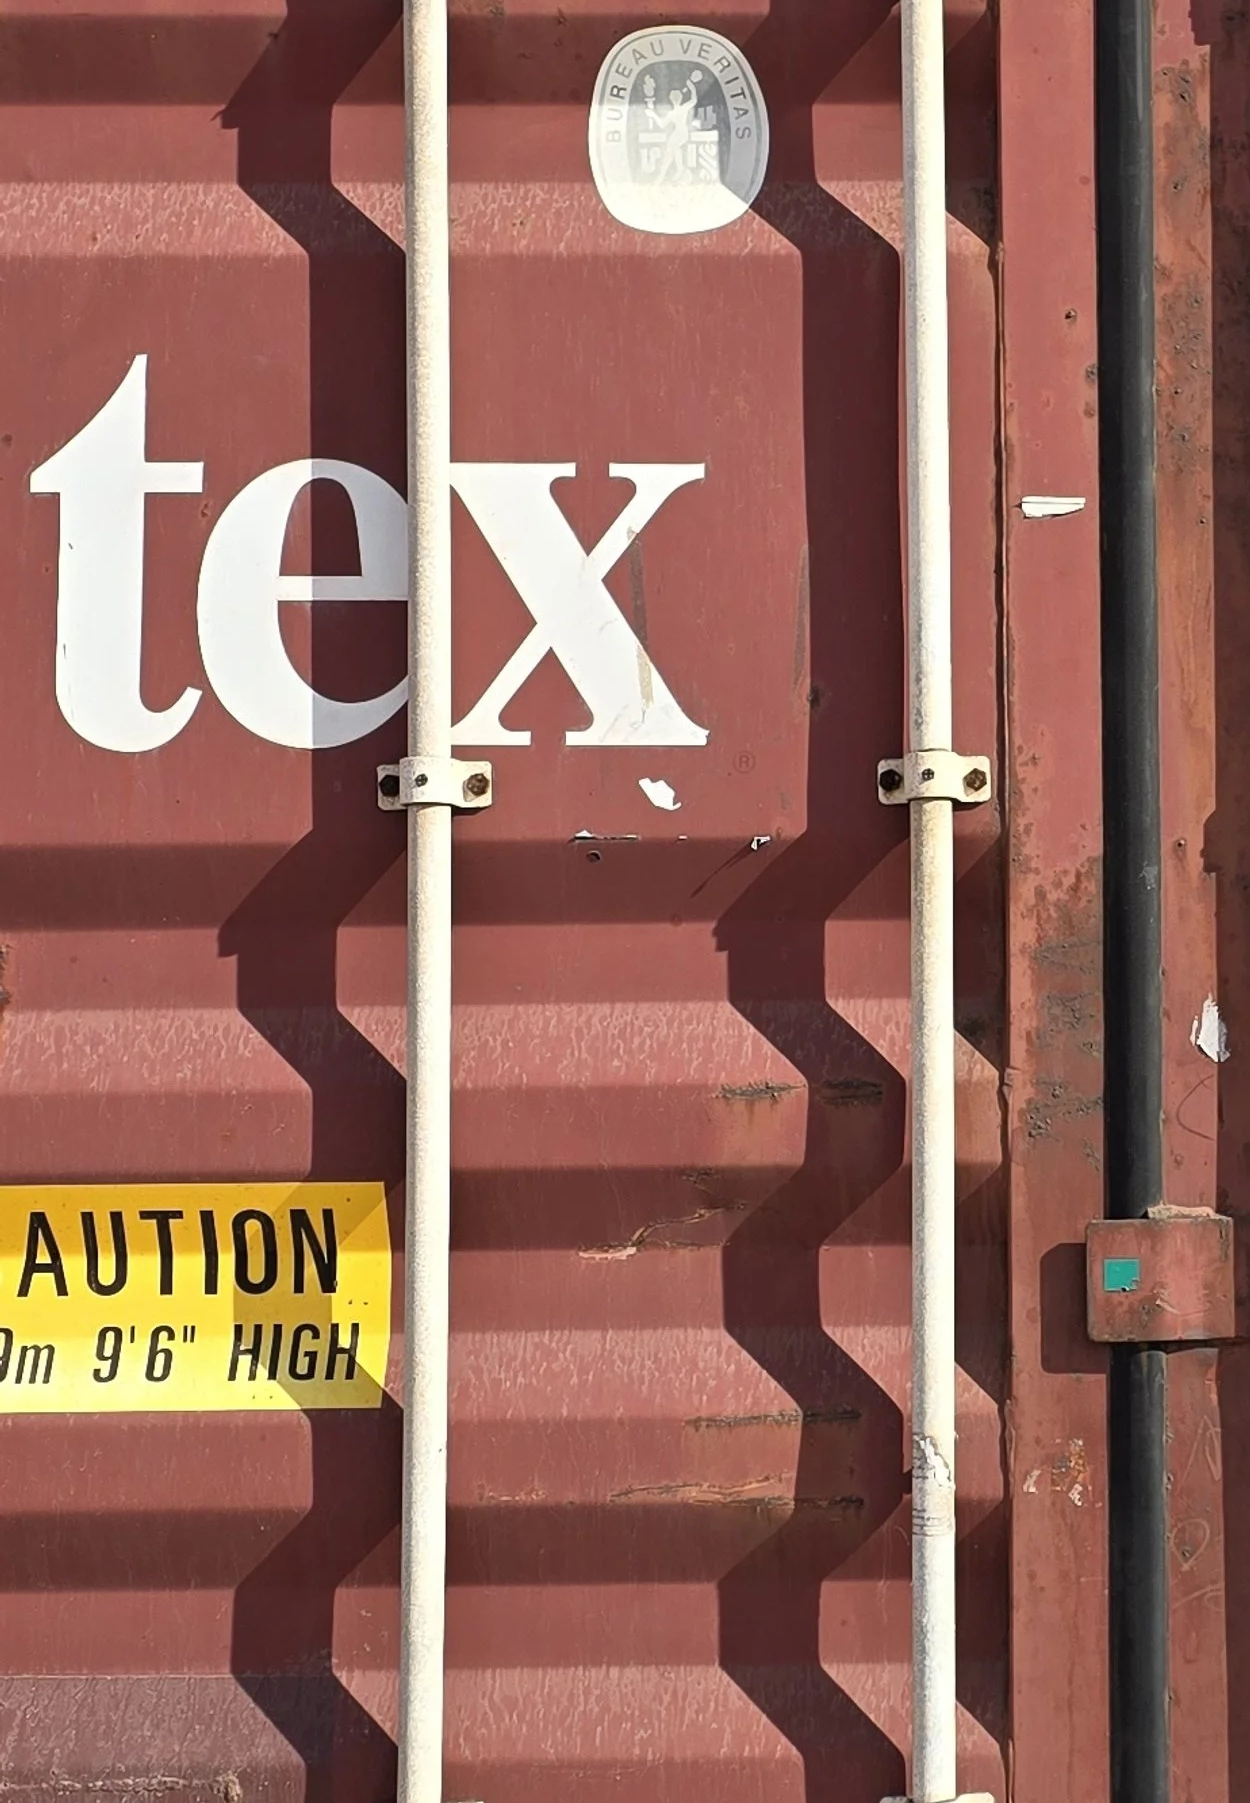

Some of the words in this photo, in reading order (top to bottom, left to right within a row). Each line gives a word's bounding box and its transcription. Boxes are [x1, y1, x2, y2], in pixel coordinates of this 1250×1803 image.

[606, 39, 664, 143] BUREAU
[679, 37, 752, 140] VERITAS
[29, 354, 709, 753] tex
[17, 1208, 338, 1297] AUTION
[228, 1323, 360, 1381] HIGH
